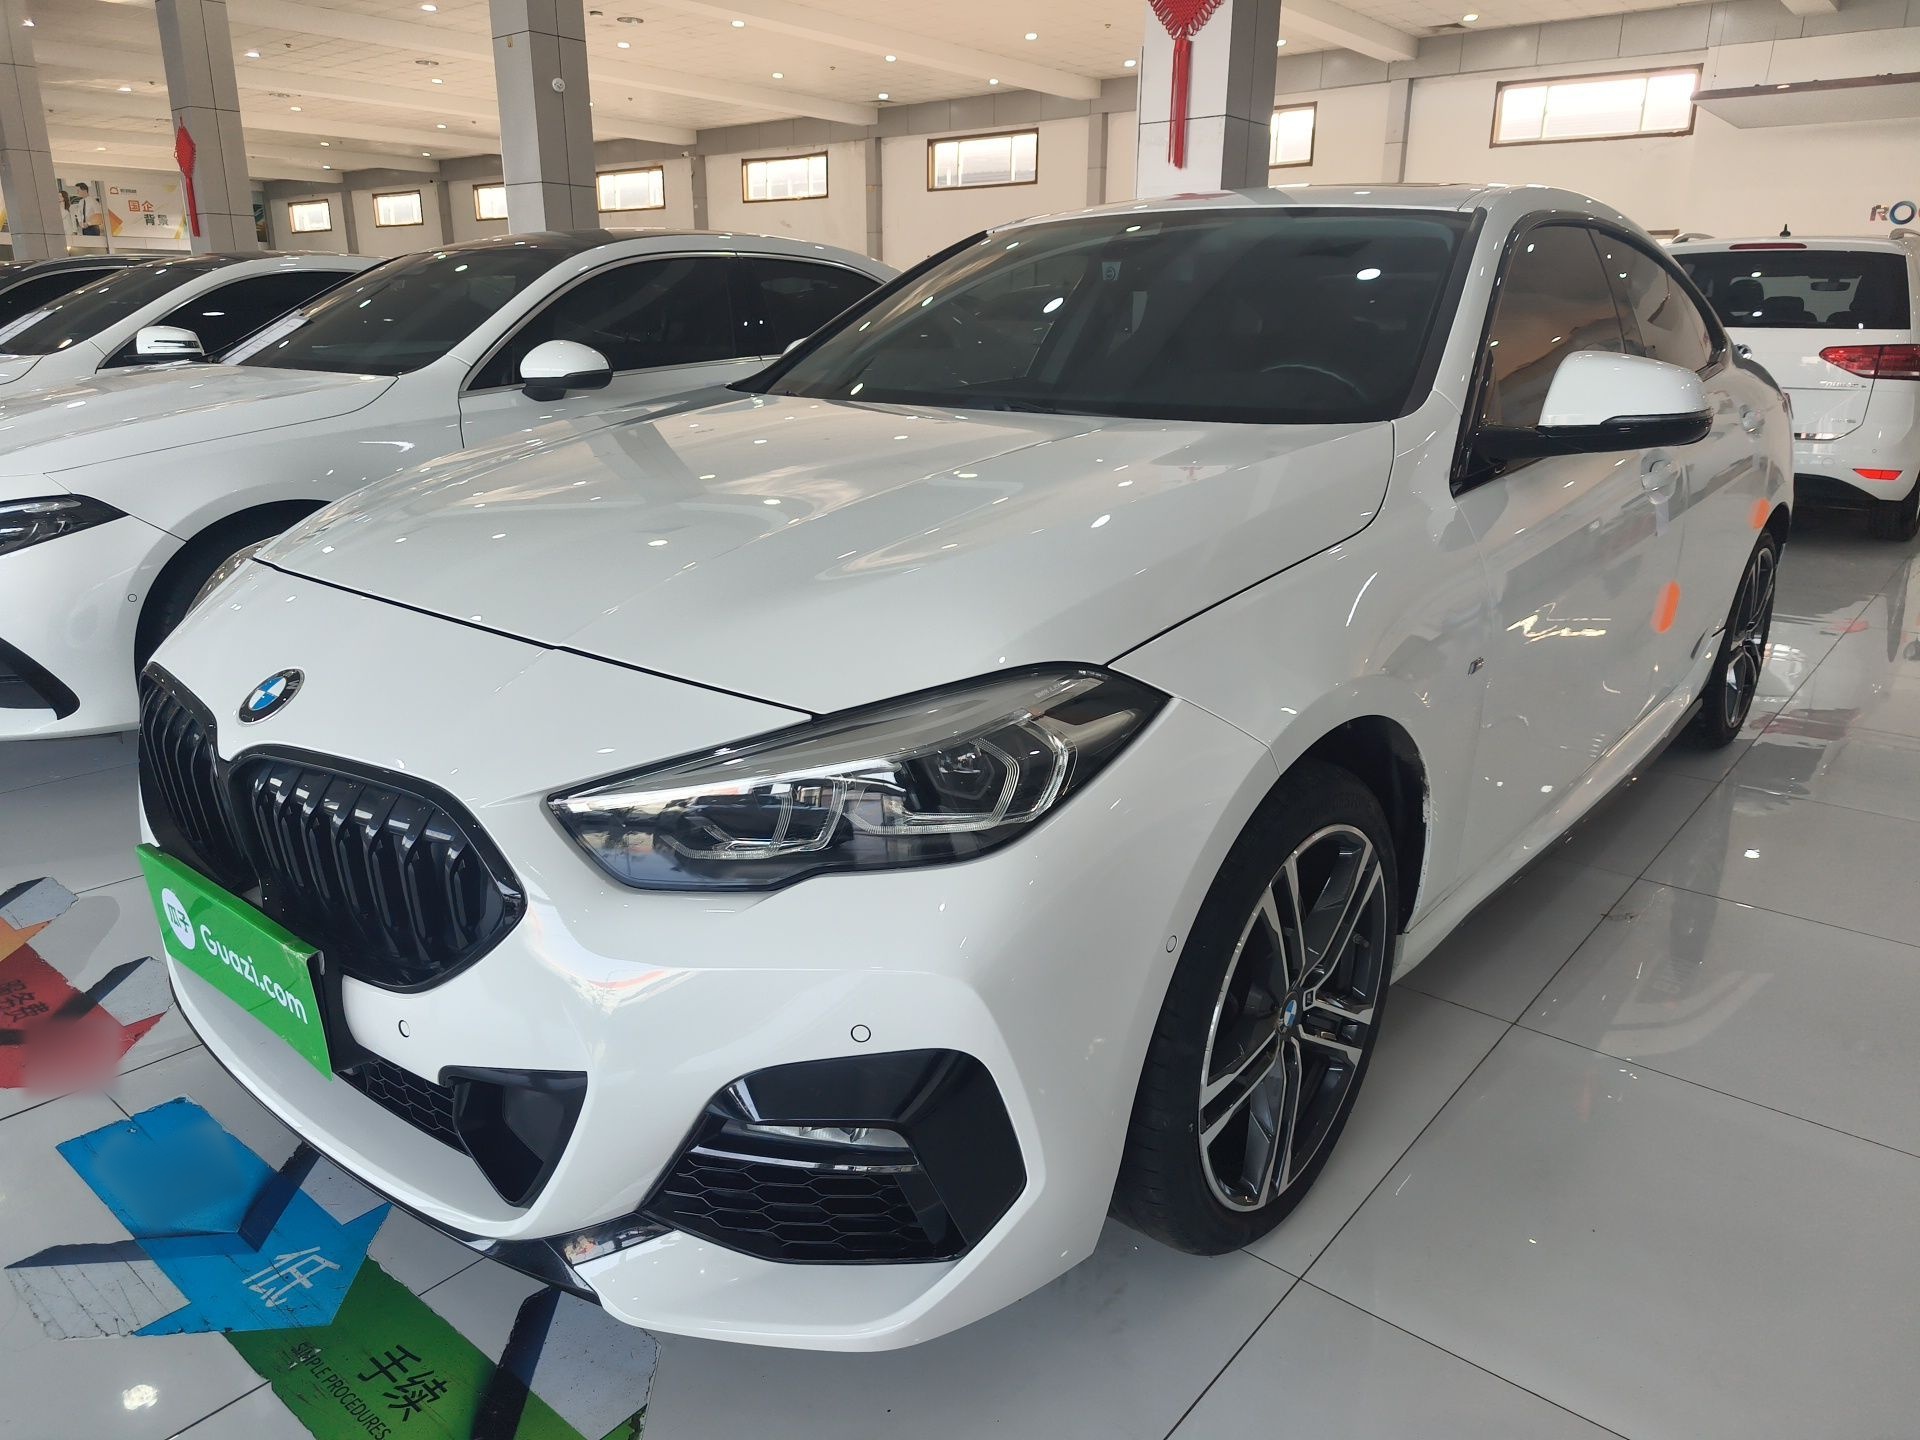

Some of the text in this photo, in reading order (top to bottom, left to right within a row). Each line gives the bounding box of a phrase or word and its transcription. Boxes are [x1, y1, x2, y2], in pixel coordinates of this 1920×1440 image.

[128, 200, 154, 212] 国企
[144, 214, 168, 225] 背景
[1870, 200, 1920, 225] RO
[200, 924, 308, 1025] Guazi.com
[242, 1246, 340, 1307] 低
[320, 1373, 392, 1440] PROCEDURES
[357, 1344, 448, 1422] 手续
